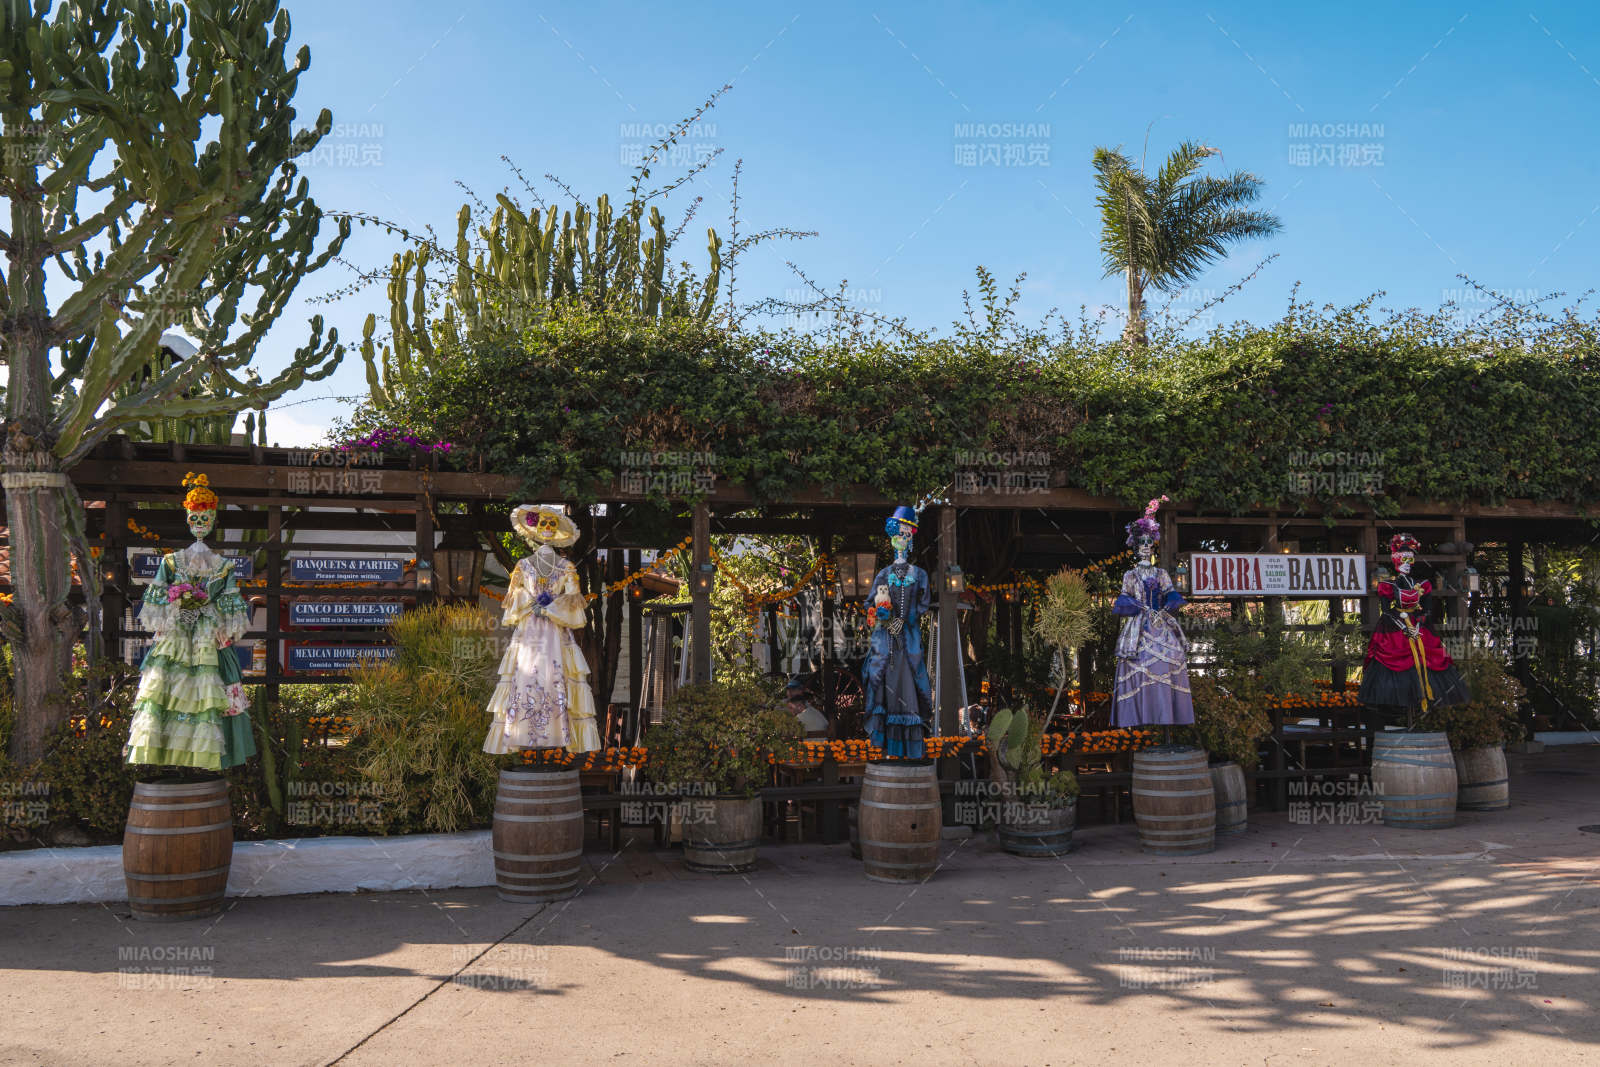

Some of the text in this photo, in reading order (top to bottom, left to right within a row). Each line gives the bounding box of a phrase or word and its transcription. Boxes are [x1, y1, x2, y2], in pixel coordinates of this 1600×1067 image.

[296, 560, 398, 570] BANQUETS & PARTIES
[1194, 558, 1262, 590] BARRA
[1288, 558, 1360, 590] BARRA
[296, 605, 398, 614] CINCO DE MEE-YO!
[295, 649, 330, 658] MEXICAN
